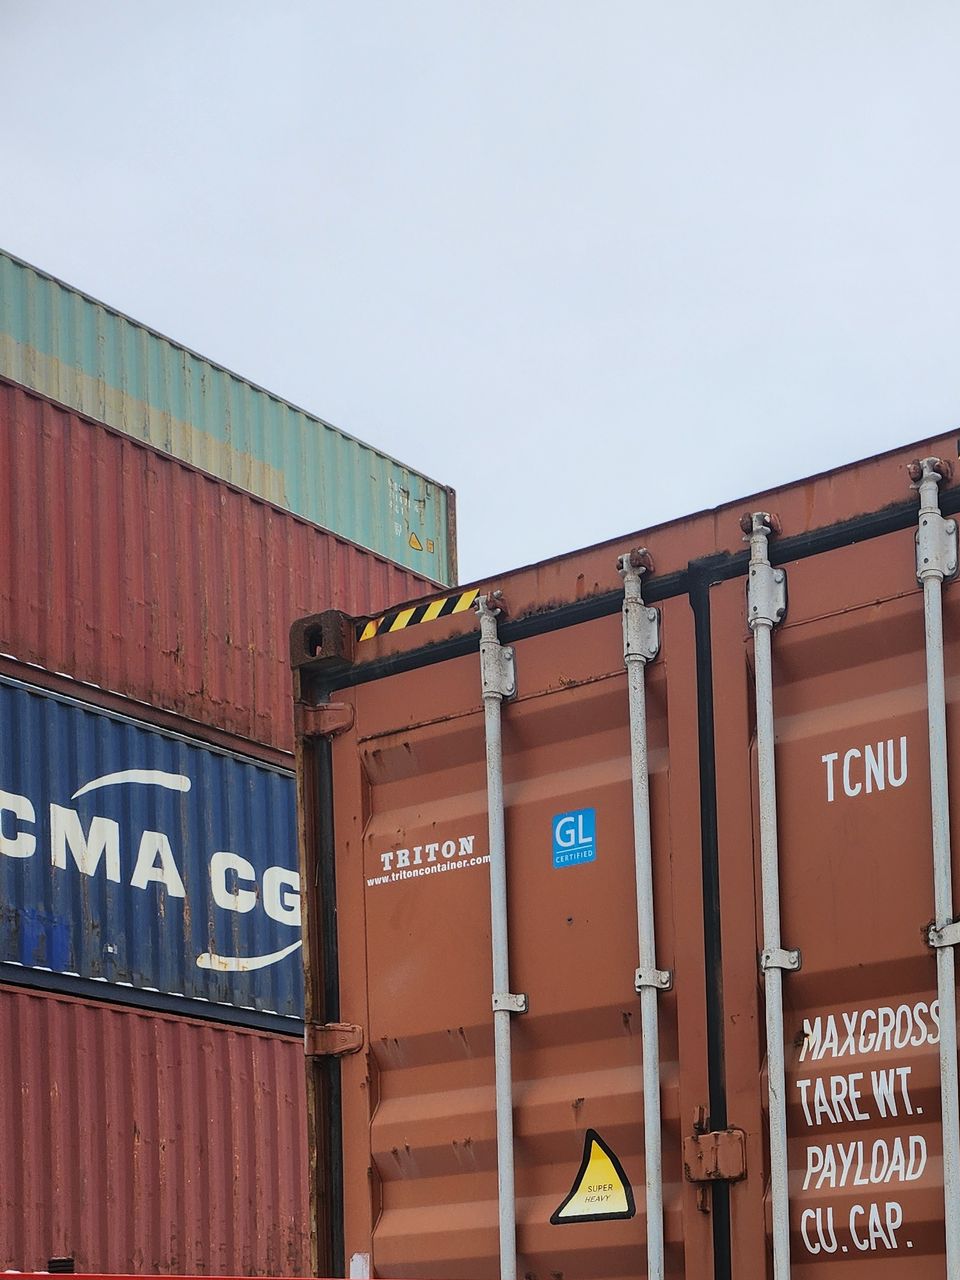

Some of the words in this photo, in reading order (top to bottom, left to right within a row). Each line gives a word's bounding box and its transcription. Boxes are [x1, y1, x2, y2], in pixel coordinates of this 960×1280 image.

[822, 735, 909, 802] TCNU
[0, 789, 187, 898] CMA
[555, 814, 593, 848] GL
[366, 854, 491, 887] www.tritoncontainer.com
[380, 835, 475, 871] TRITON
[555, 850, 593, 864] CERTIFIED
[798, 1000, 941, 1063] MAXGROSS
[796, 1072, 871, 1127] TARE
[871, 1066, 923, 1118] WT.
[801, 1134, 928, 1191] PAYLOAD
[584, 1194, 612, 1203] HEAVY
[587, 1183, 613, 1193] SUPER
